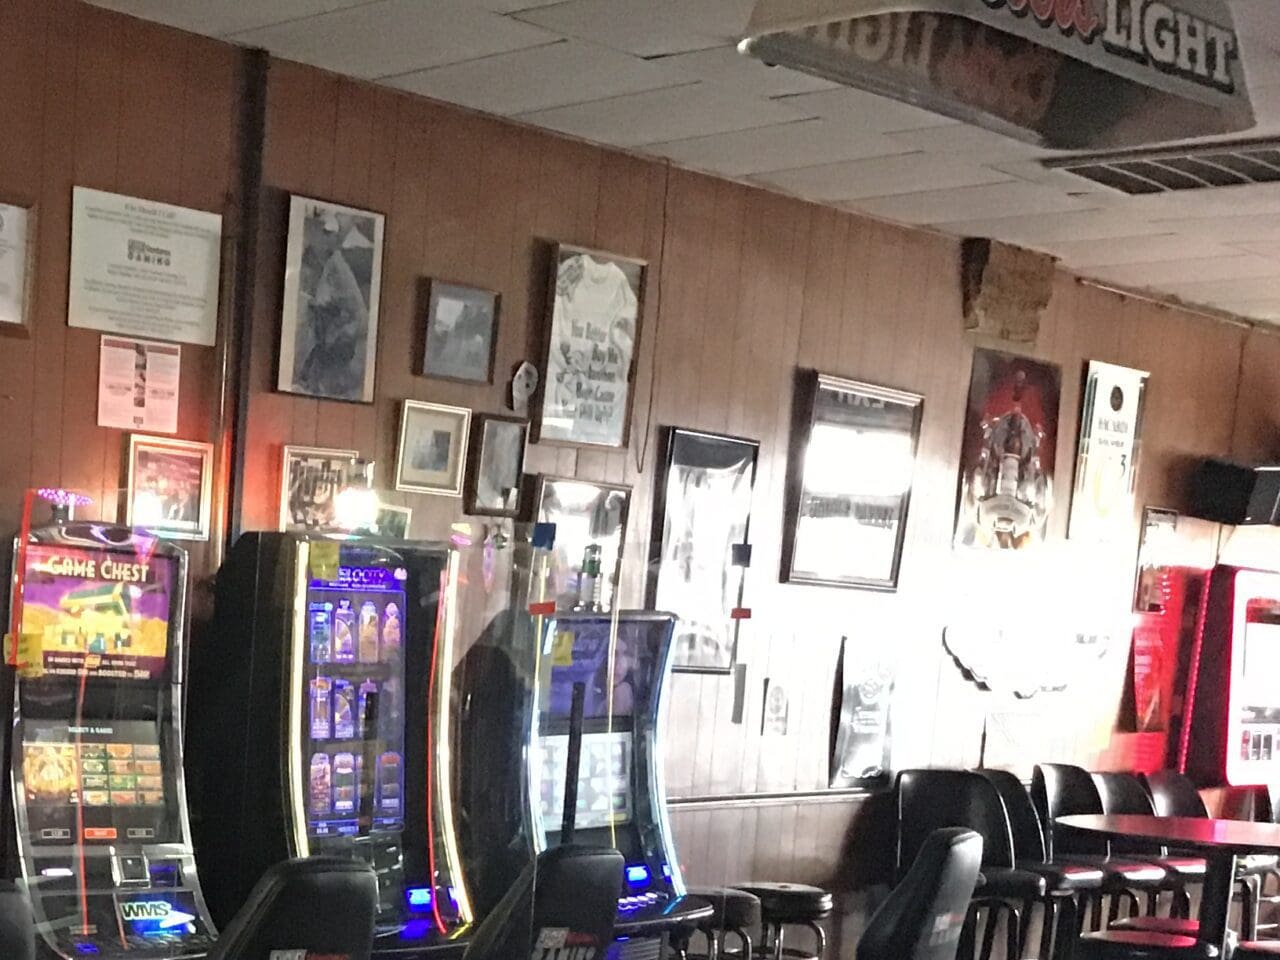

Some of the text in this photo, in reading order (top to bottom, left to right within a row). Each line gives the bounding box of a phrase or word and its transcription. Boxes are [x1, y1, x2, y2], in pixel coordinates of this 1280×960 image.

[1104, 0, 1236, 93] LIGHT
[47, 555, 150, 582] GAME CHEST
[120, 902, 170, 919] WMS
